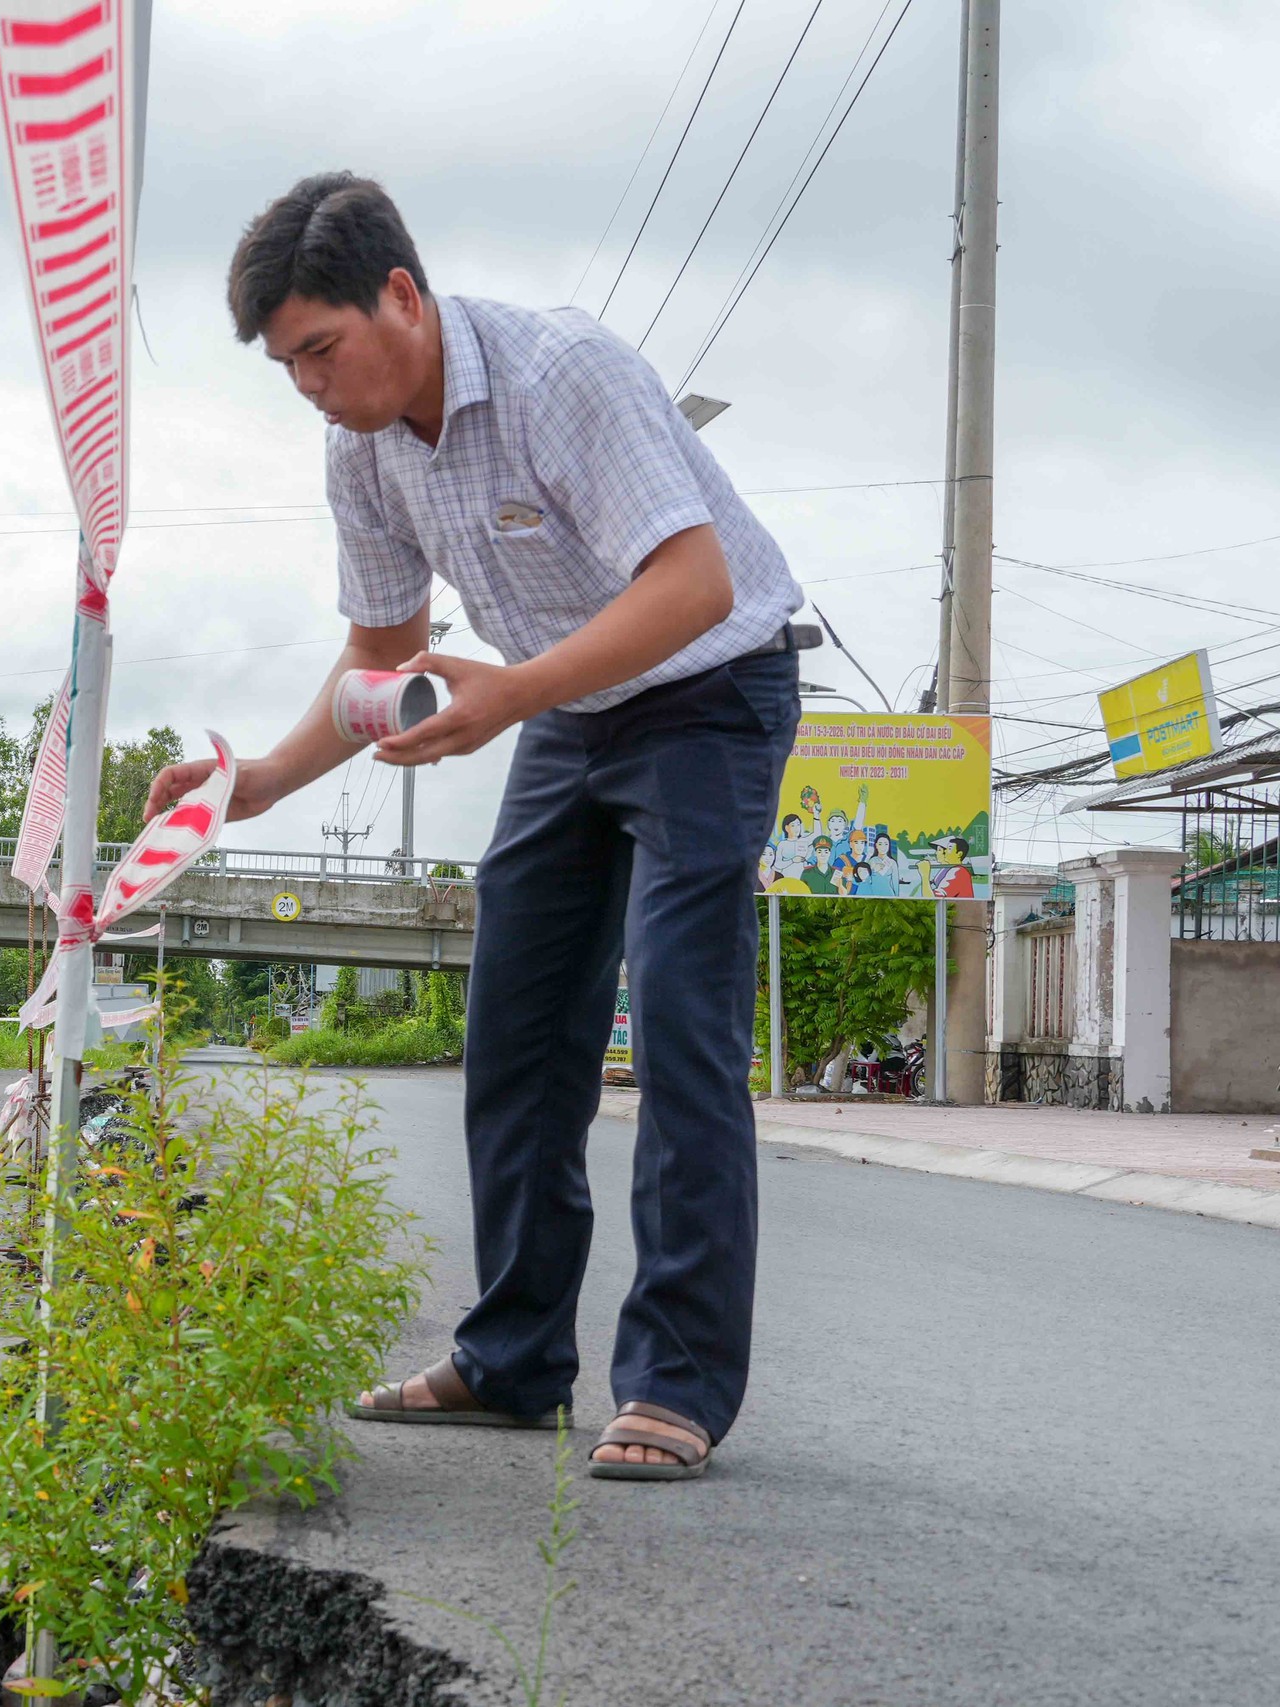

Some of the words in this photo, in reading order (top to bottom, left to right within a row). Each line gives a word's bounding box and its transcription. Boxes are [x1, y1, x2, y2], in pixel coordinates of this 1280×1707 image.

[857, 726, 866, 737] TRI
[1147, 711, 1198, 746] POSTMART
[829, 745, 839, 757] XVI
[278, 902, 294, 912] 2M
[196, 923, 207, 931] 2M
[615, 1014, 627, 1024] UA
